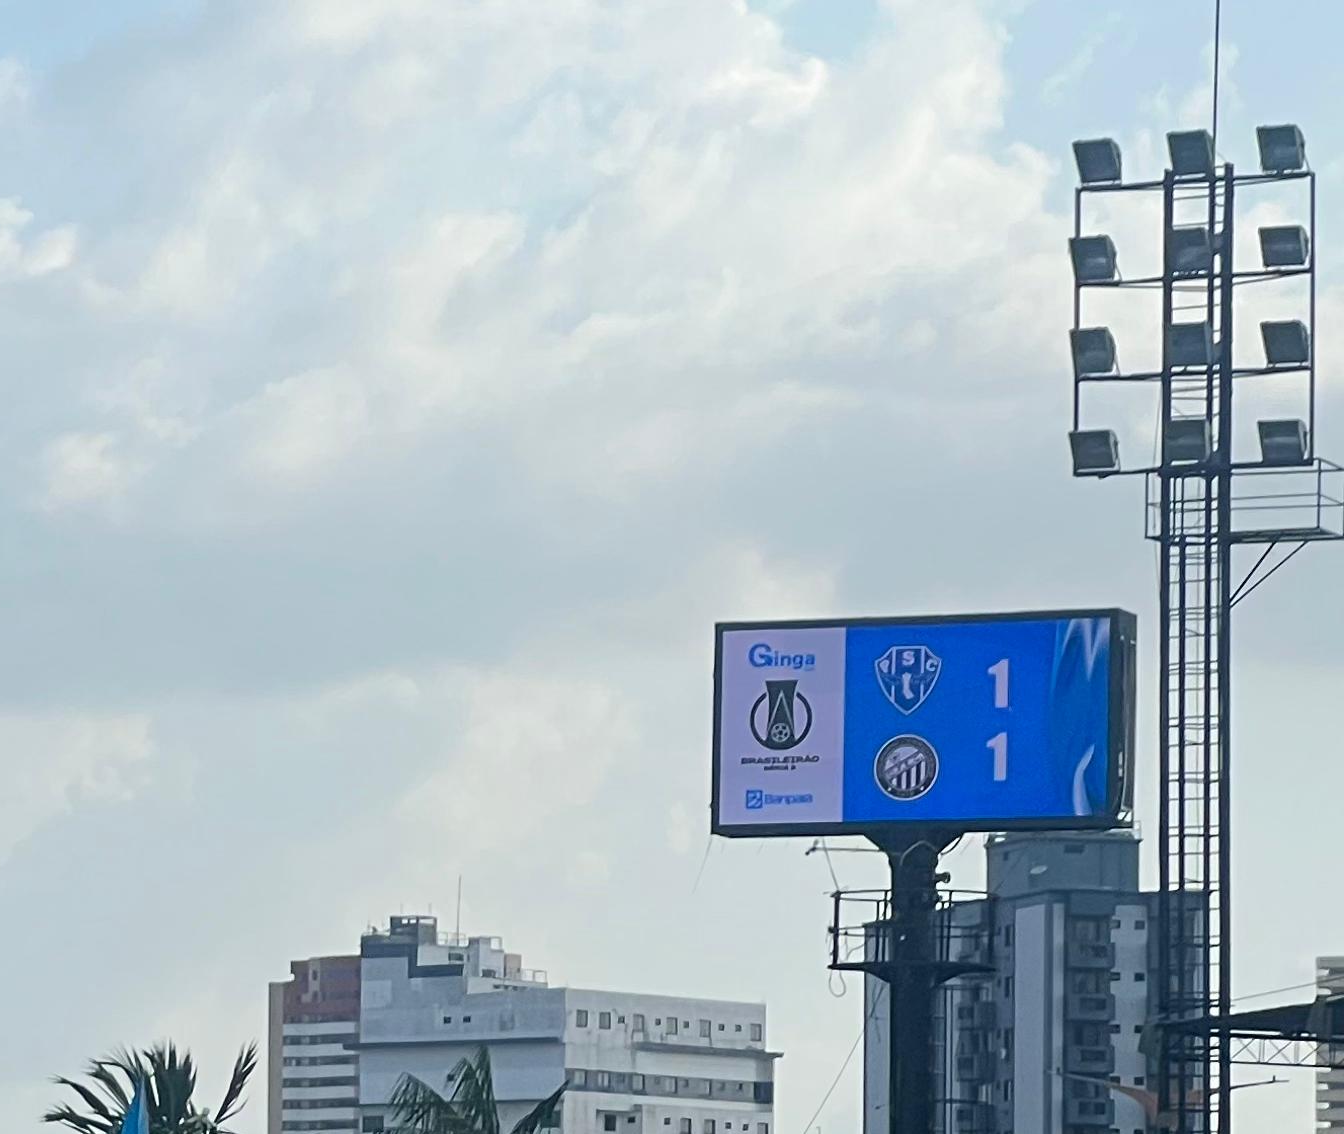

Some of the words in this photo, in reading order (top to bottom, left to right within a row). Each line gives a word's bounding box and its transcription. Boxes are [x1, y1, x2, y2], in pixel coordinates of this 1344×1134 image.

[749, 643, 815, 670] Ginga
[988, 659, 1009, 708] 1
[986, 732, 1007, 781] 1
